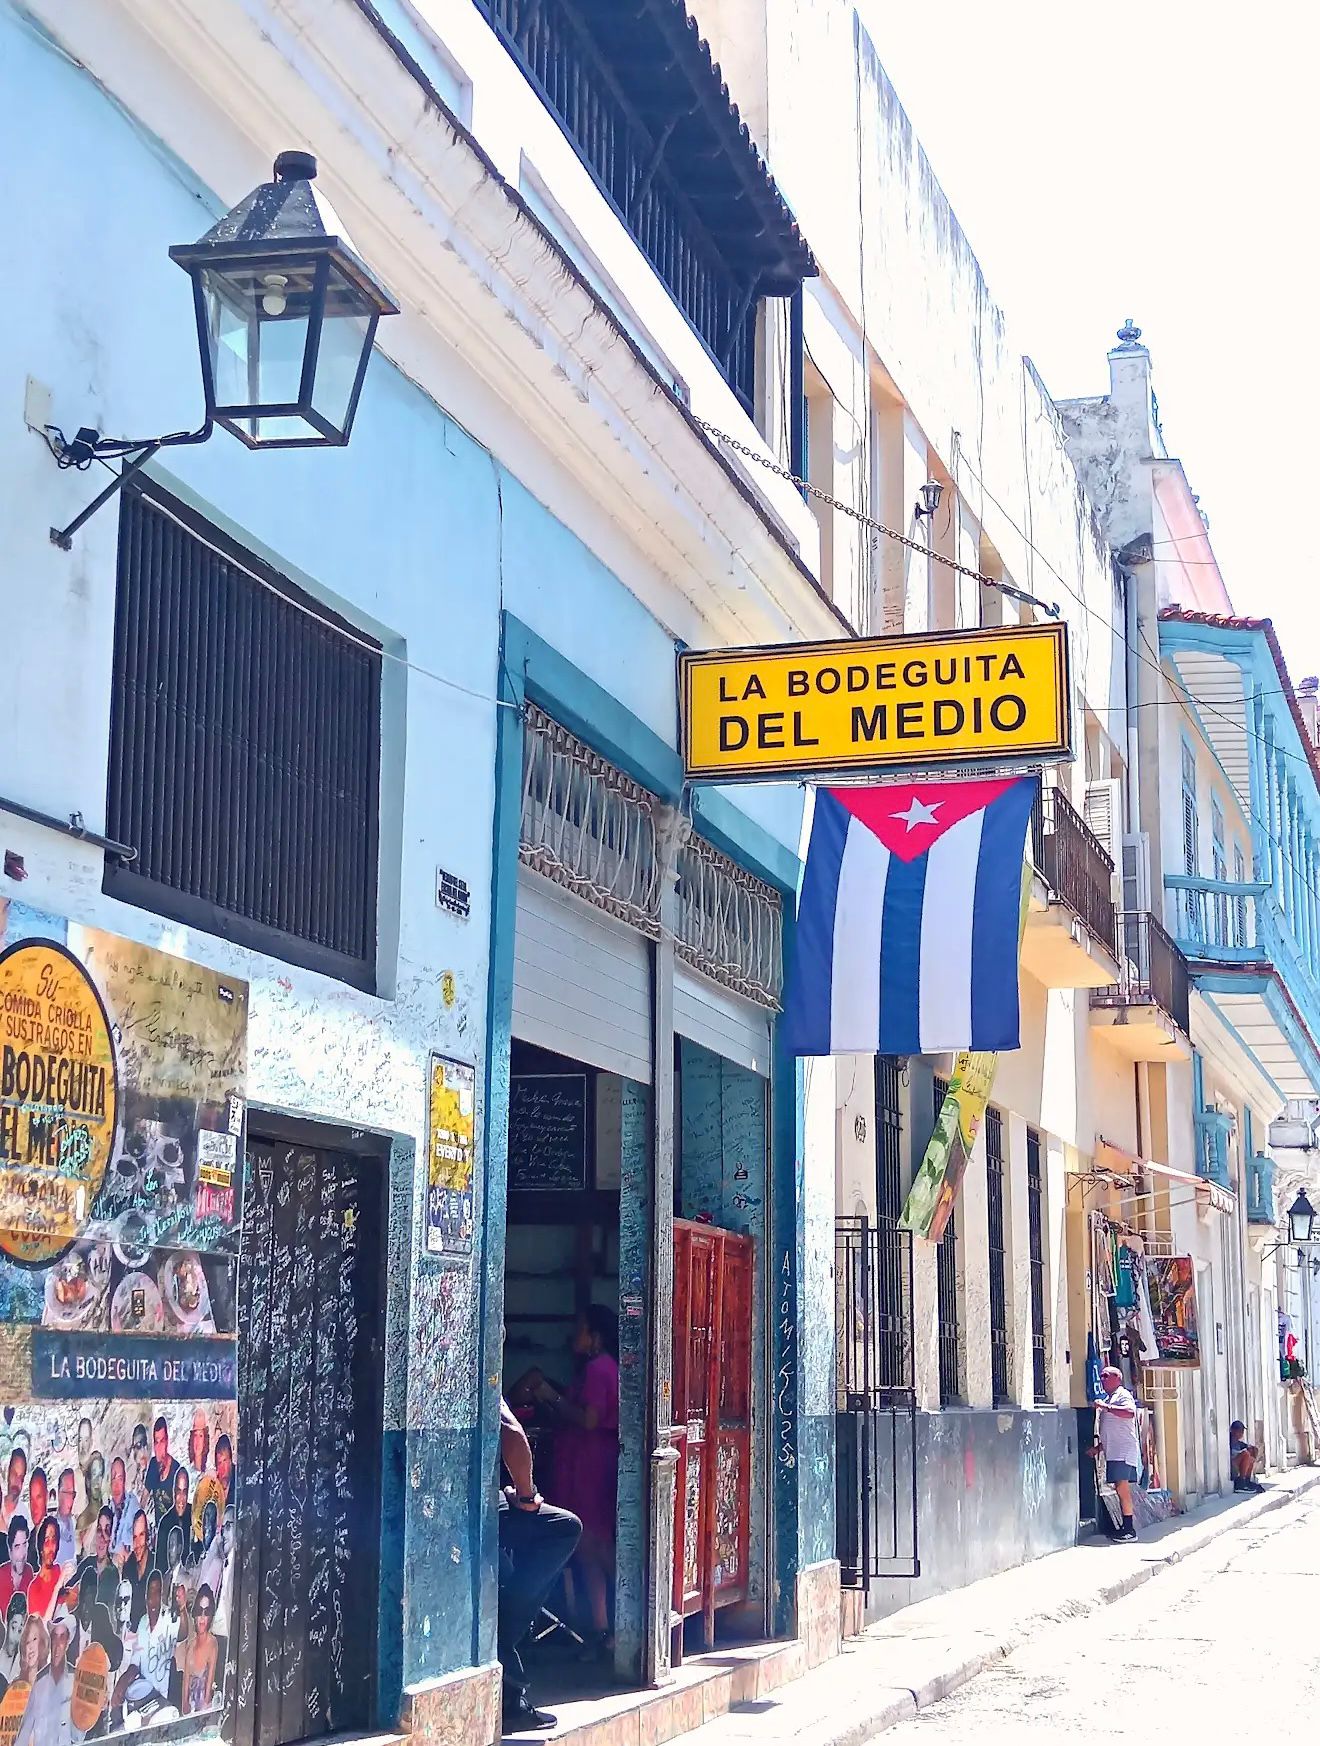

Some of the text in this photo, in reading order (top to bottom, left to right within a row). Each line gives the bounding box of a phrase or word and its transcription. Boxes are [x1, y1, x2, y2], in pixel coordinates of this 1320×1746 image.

[719, 653, 1026, 703] LA BODEGUITA
[719, 694, 1027, 752] DEL MEDIO
[48, 1003, 93, 1033] CRIOLLA
[2, 1044, 105, 1117] BODEGUITA
[0, 1106, 22, 1160] EL
[50, 1354, 71, 1379] LA
[76, 1356, 158, 1381] BODEGUITA
[163, 1359, 189, 1382] DEL
